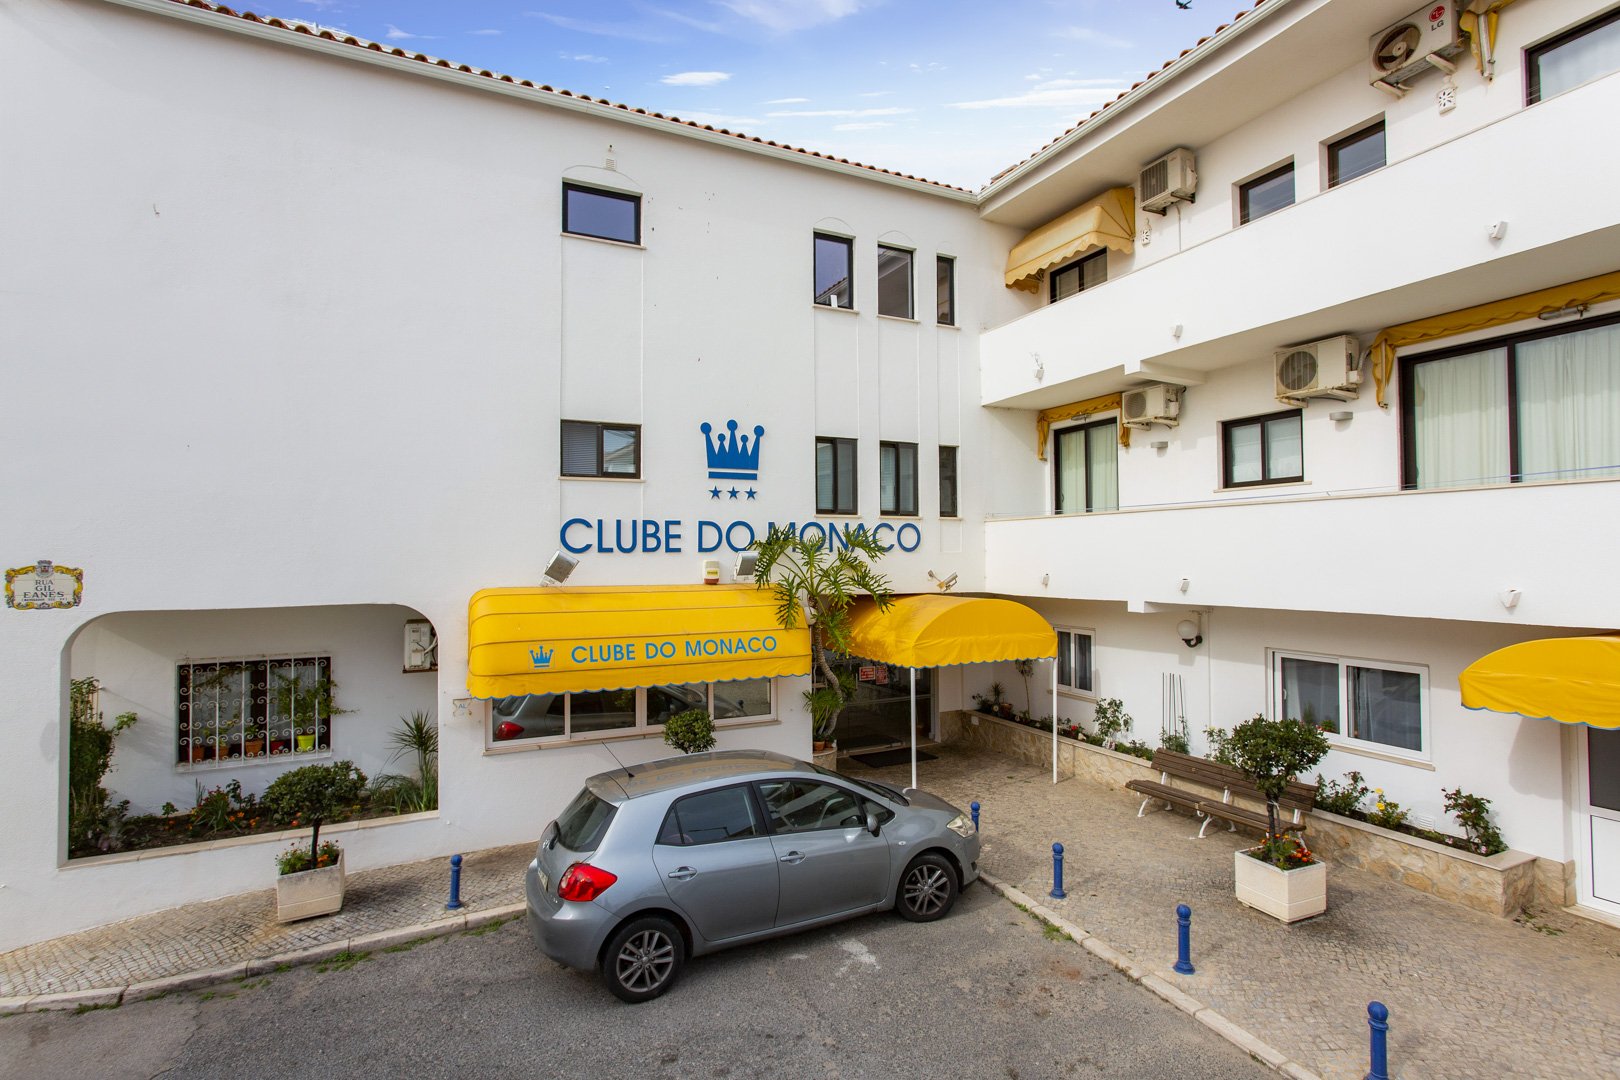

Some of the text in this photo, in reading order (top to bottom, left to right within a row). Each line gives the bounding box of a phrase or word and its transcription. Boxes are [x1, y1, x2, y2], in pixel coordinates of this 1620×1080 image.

[1431, 20, 1444, 31] LG
[560, 518, 921, 554] CLUBE DO MONACO
[571, 636, 777, 664] CLUBE DO MONACO
